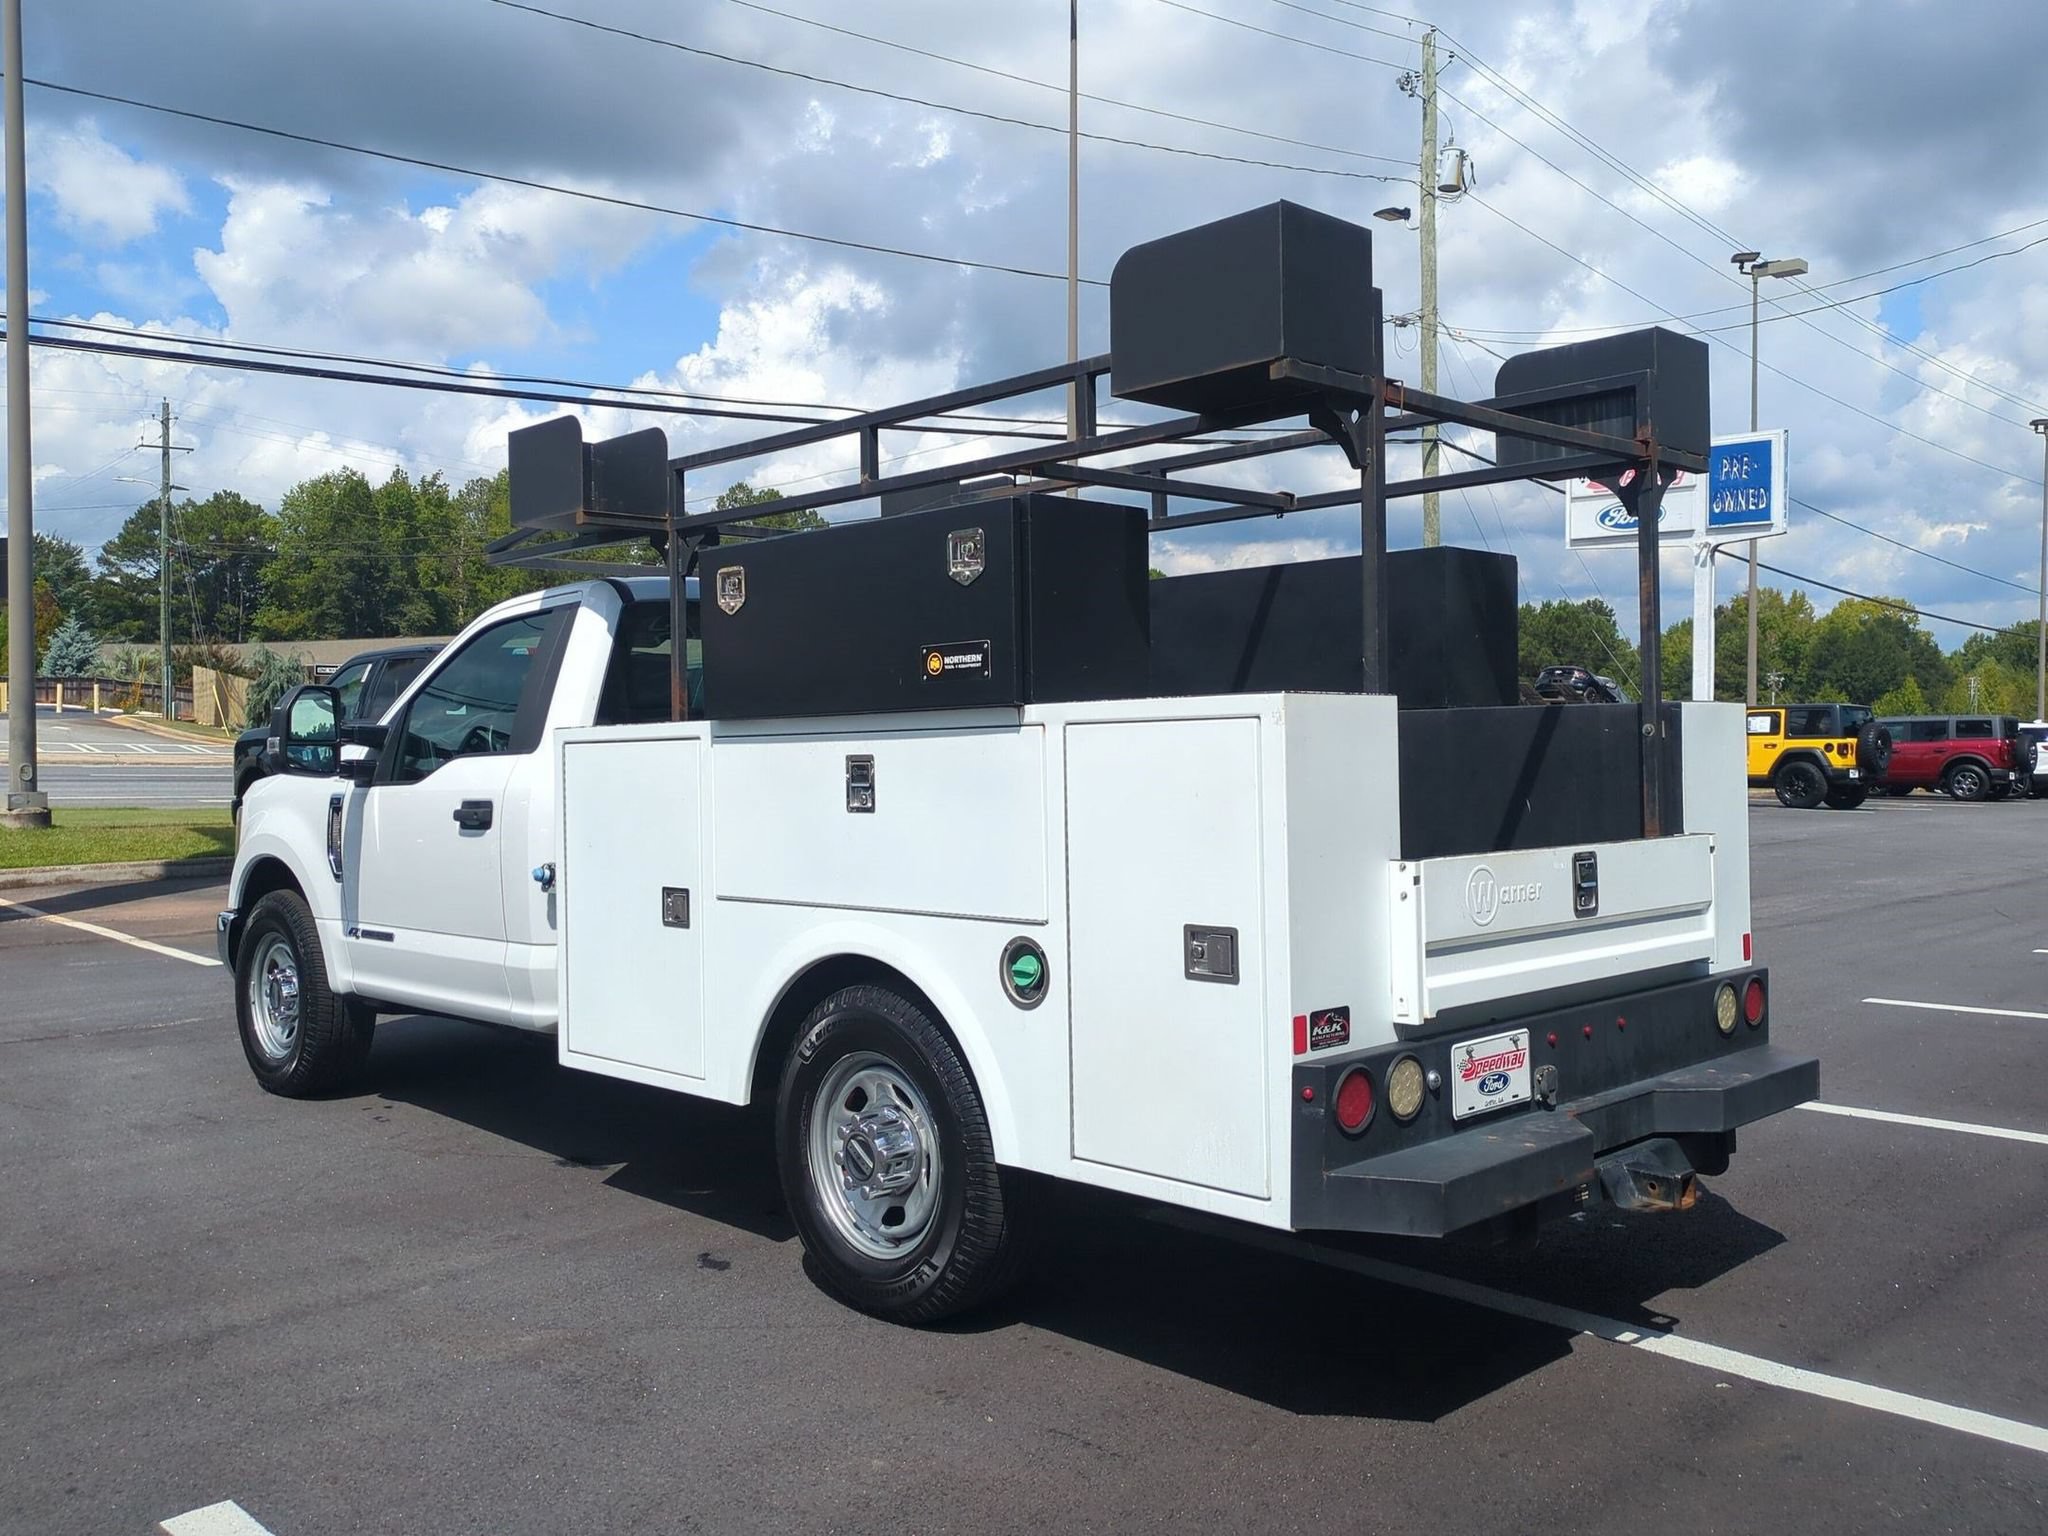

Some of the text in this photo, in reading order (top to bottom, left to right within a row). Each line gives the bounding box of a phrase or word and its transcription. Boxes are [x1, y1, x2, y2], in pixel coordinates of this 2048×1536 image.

[1713, 488, 1767, 514] OWNED
[944, 654, 983, 664] NORTHERN
[1469, 878, 1543, 915] Warner
[1312, 1022, 1343, 1036] K&K
[1461, 1050, 1527, 1081] Speedway
[1483, 1075, 1505, 1092] Ford
